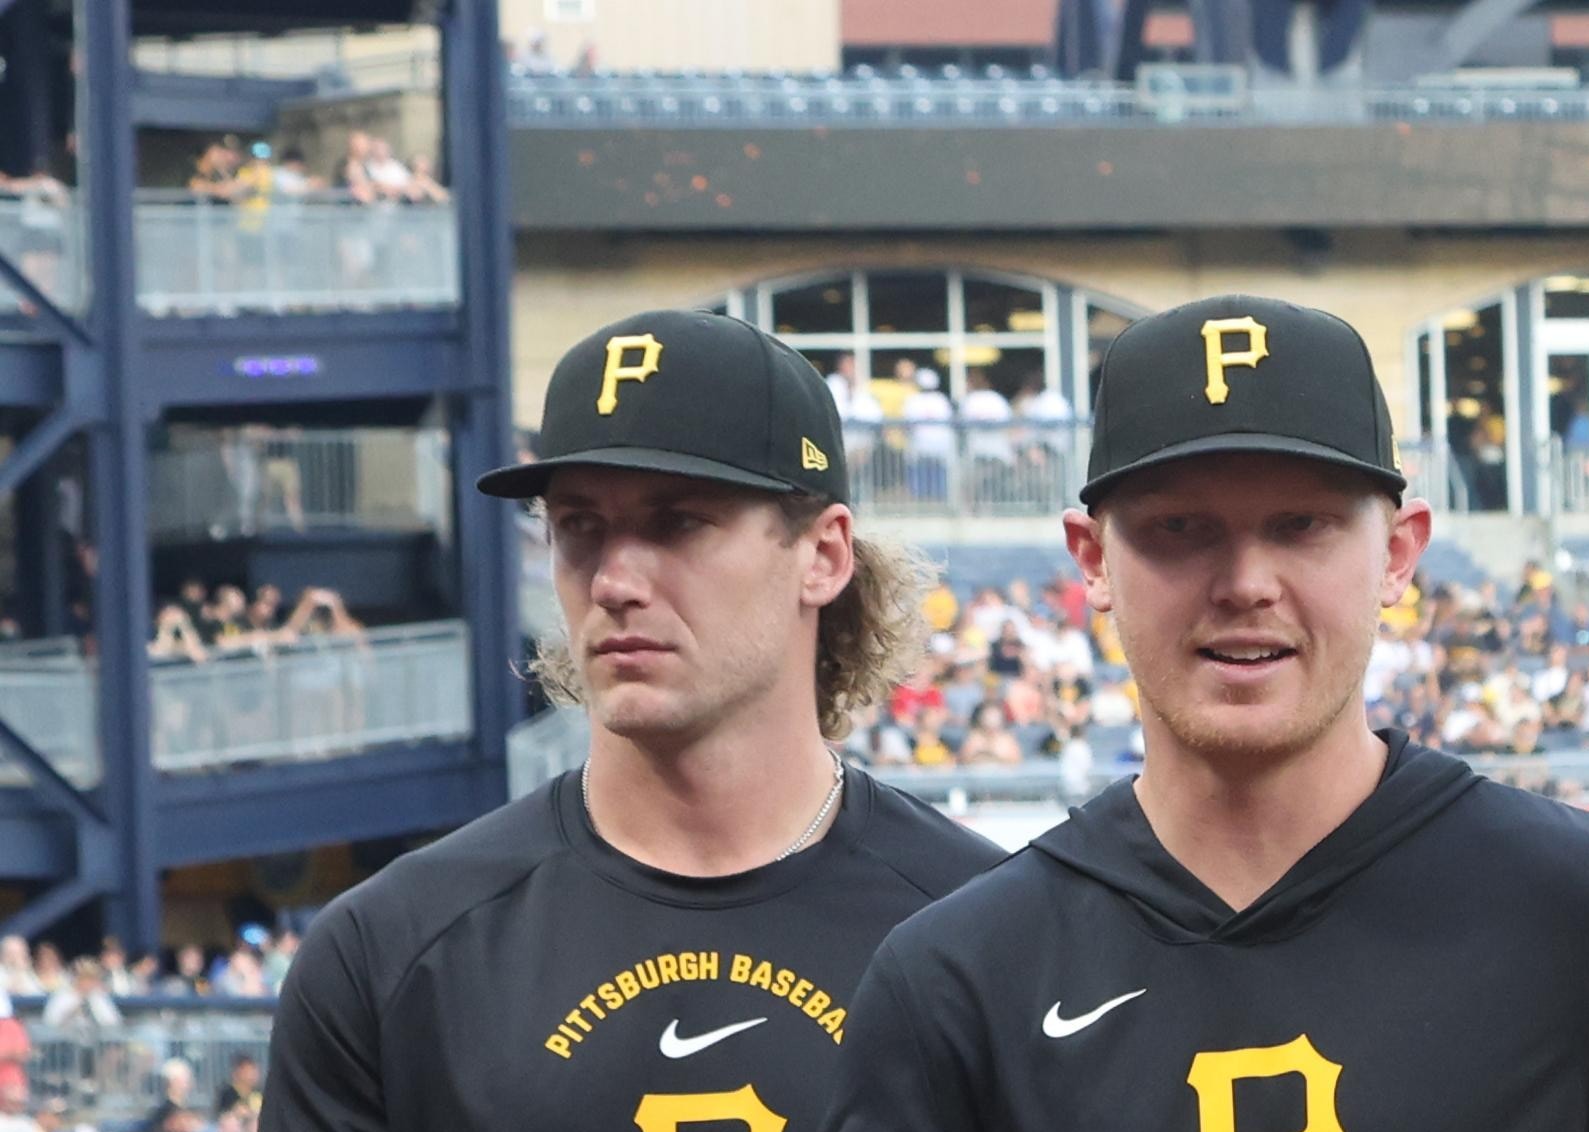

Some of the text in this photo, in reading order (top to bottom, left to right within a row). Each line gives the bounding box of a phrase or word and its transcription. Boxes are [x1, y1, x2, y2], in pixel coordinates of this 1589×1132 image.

[597, 333, 664, 415] P
[1201, 316, 1270, 404] P
[544, 951, 849, 1060] PITTSBURGH BASEBA
